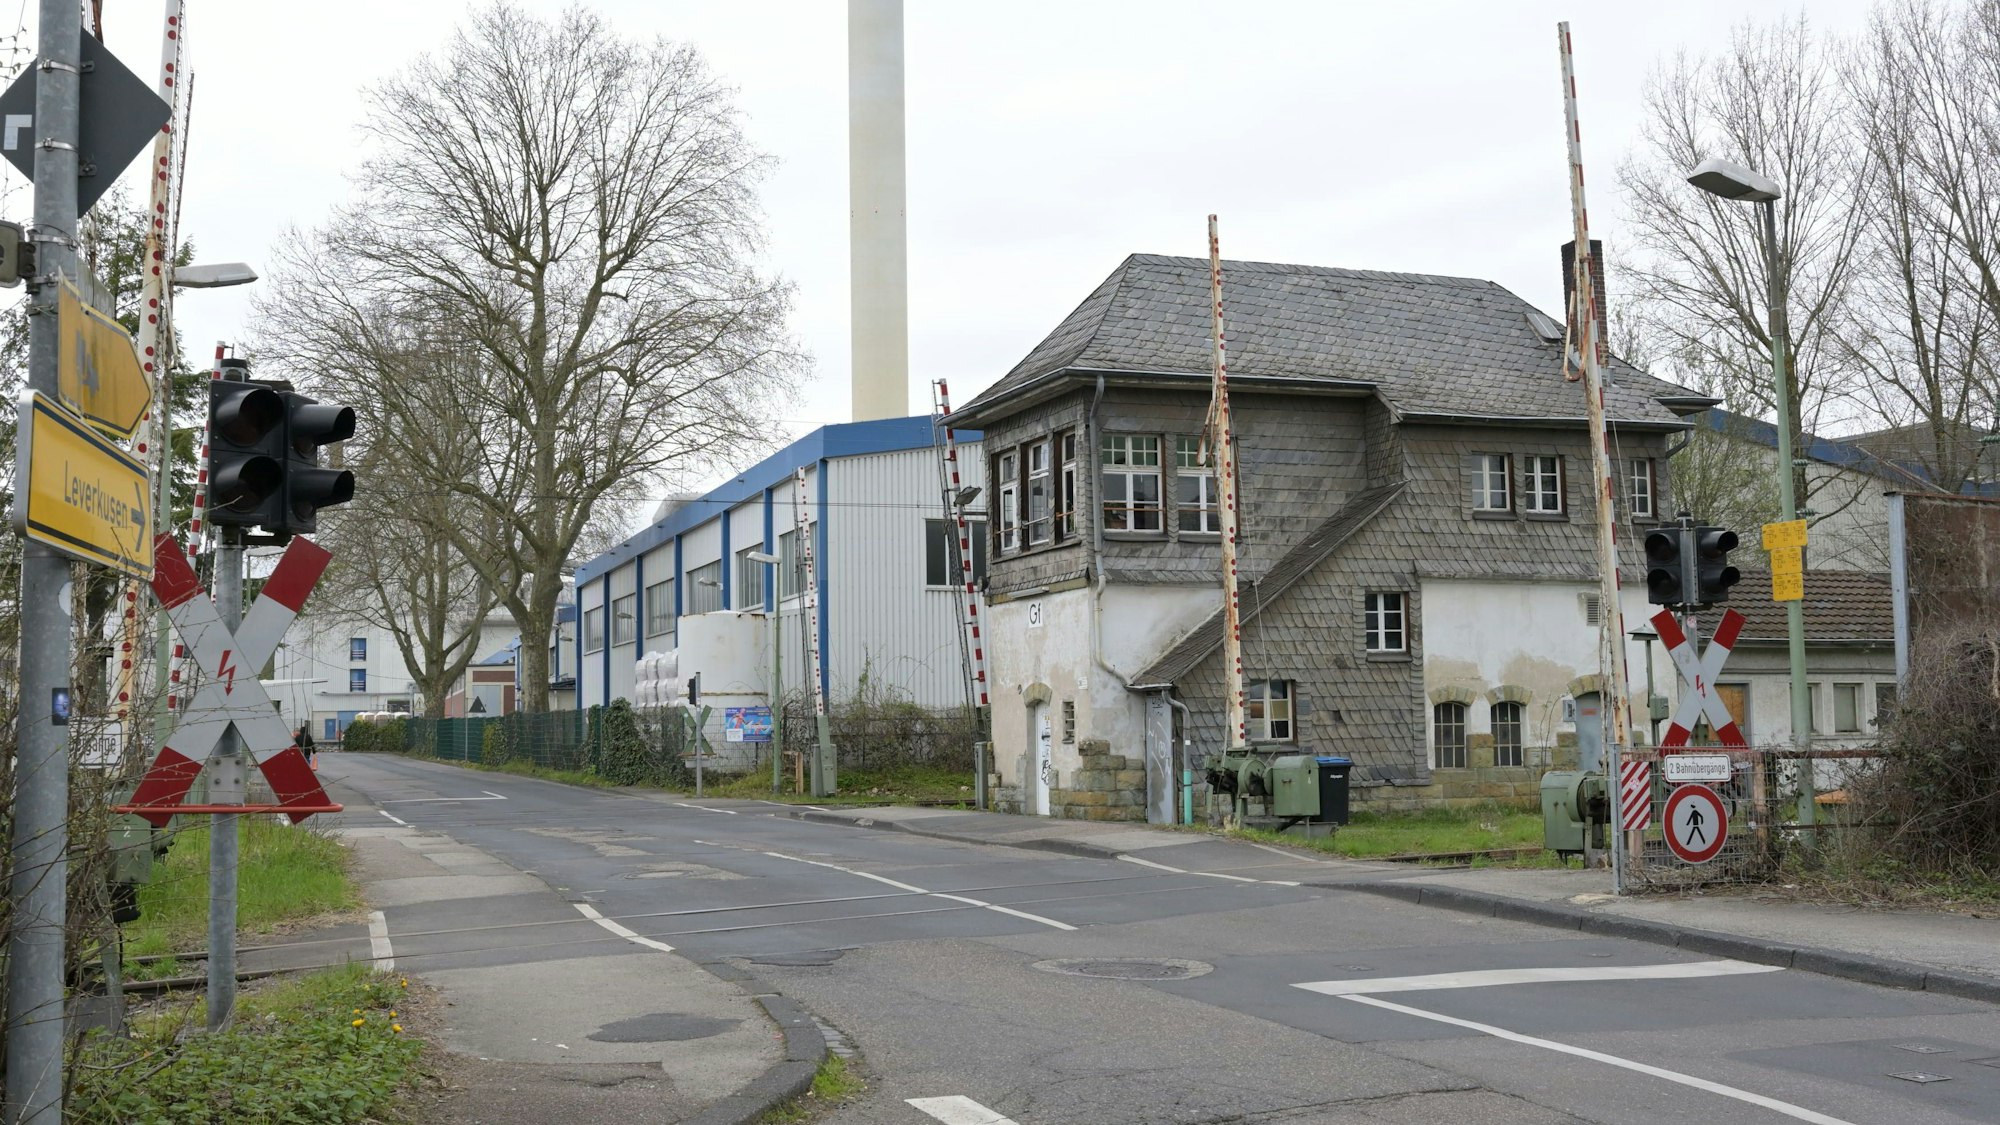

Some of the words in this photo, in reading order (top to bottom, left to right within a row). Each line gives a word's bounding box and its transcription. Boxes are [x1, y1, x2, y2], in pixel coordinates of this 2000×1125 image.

[64, 460, 128, 528] Leverkusen
[1669, 762, 1674, 774] 2
[1676, 761, 1726, 775] Bahnübergänge
